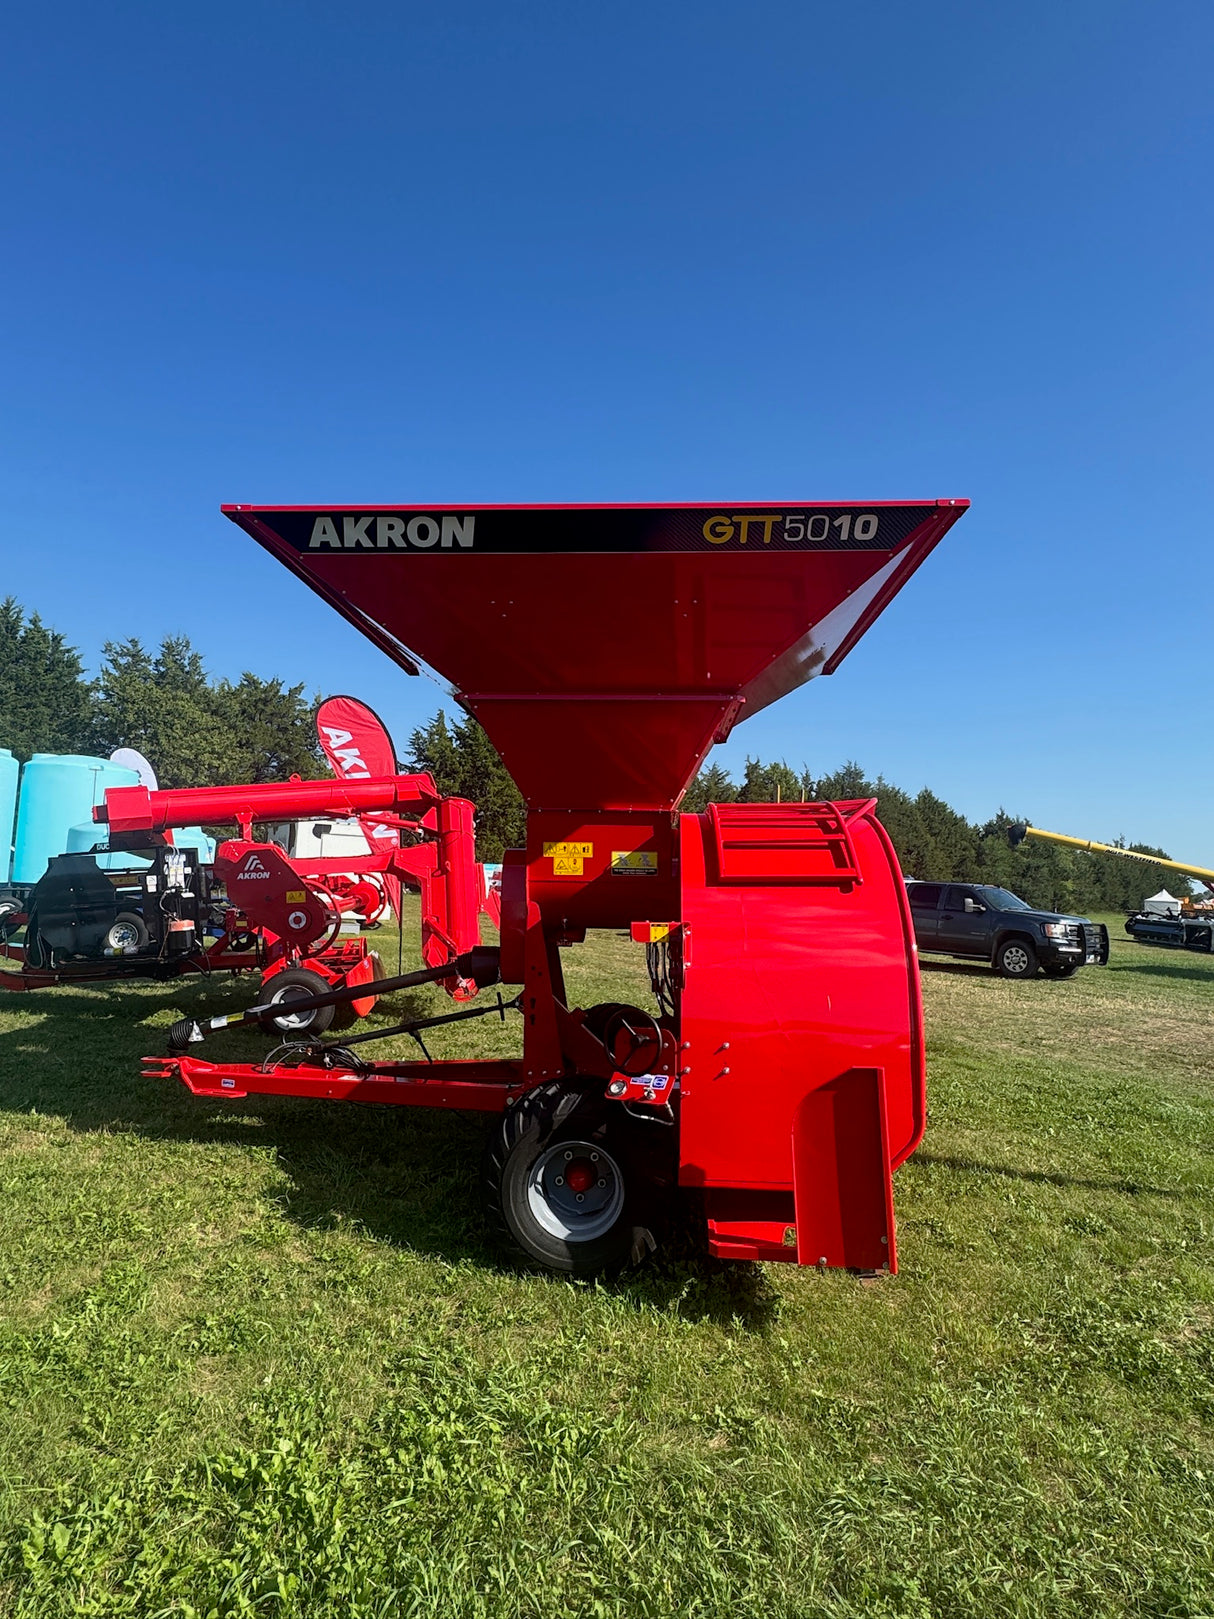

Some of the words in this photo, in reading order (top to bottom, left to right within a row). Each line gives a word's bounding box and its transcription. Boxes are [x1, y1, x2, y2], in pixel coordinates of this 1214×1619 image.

[309, 516, 475, 548] AKRON
[1123, 853, 1162, 867] WESTFIELD
[237, 871, 270, 881] AKRON
